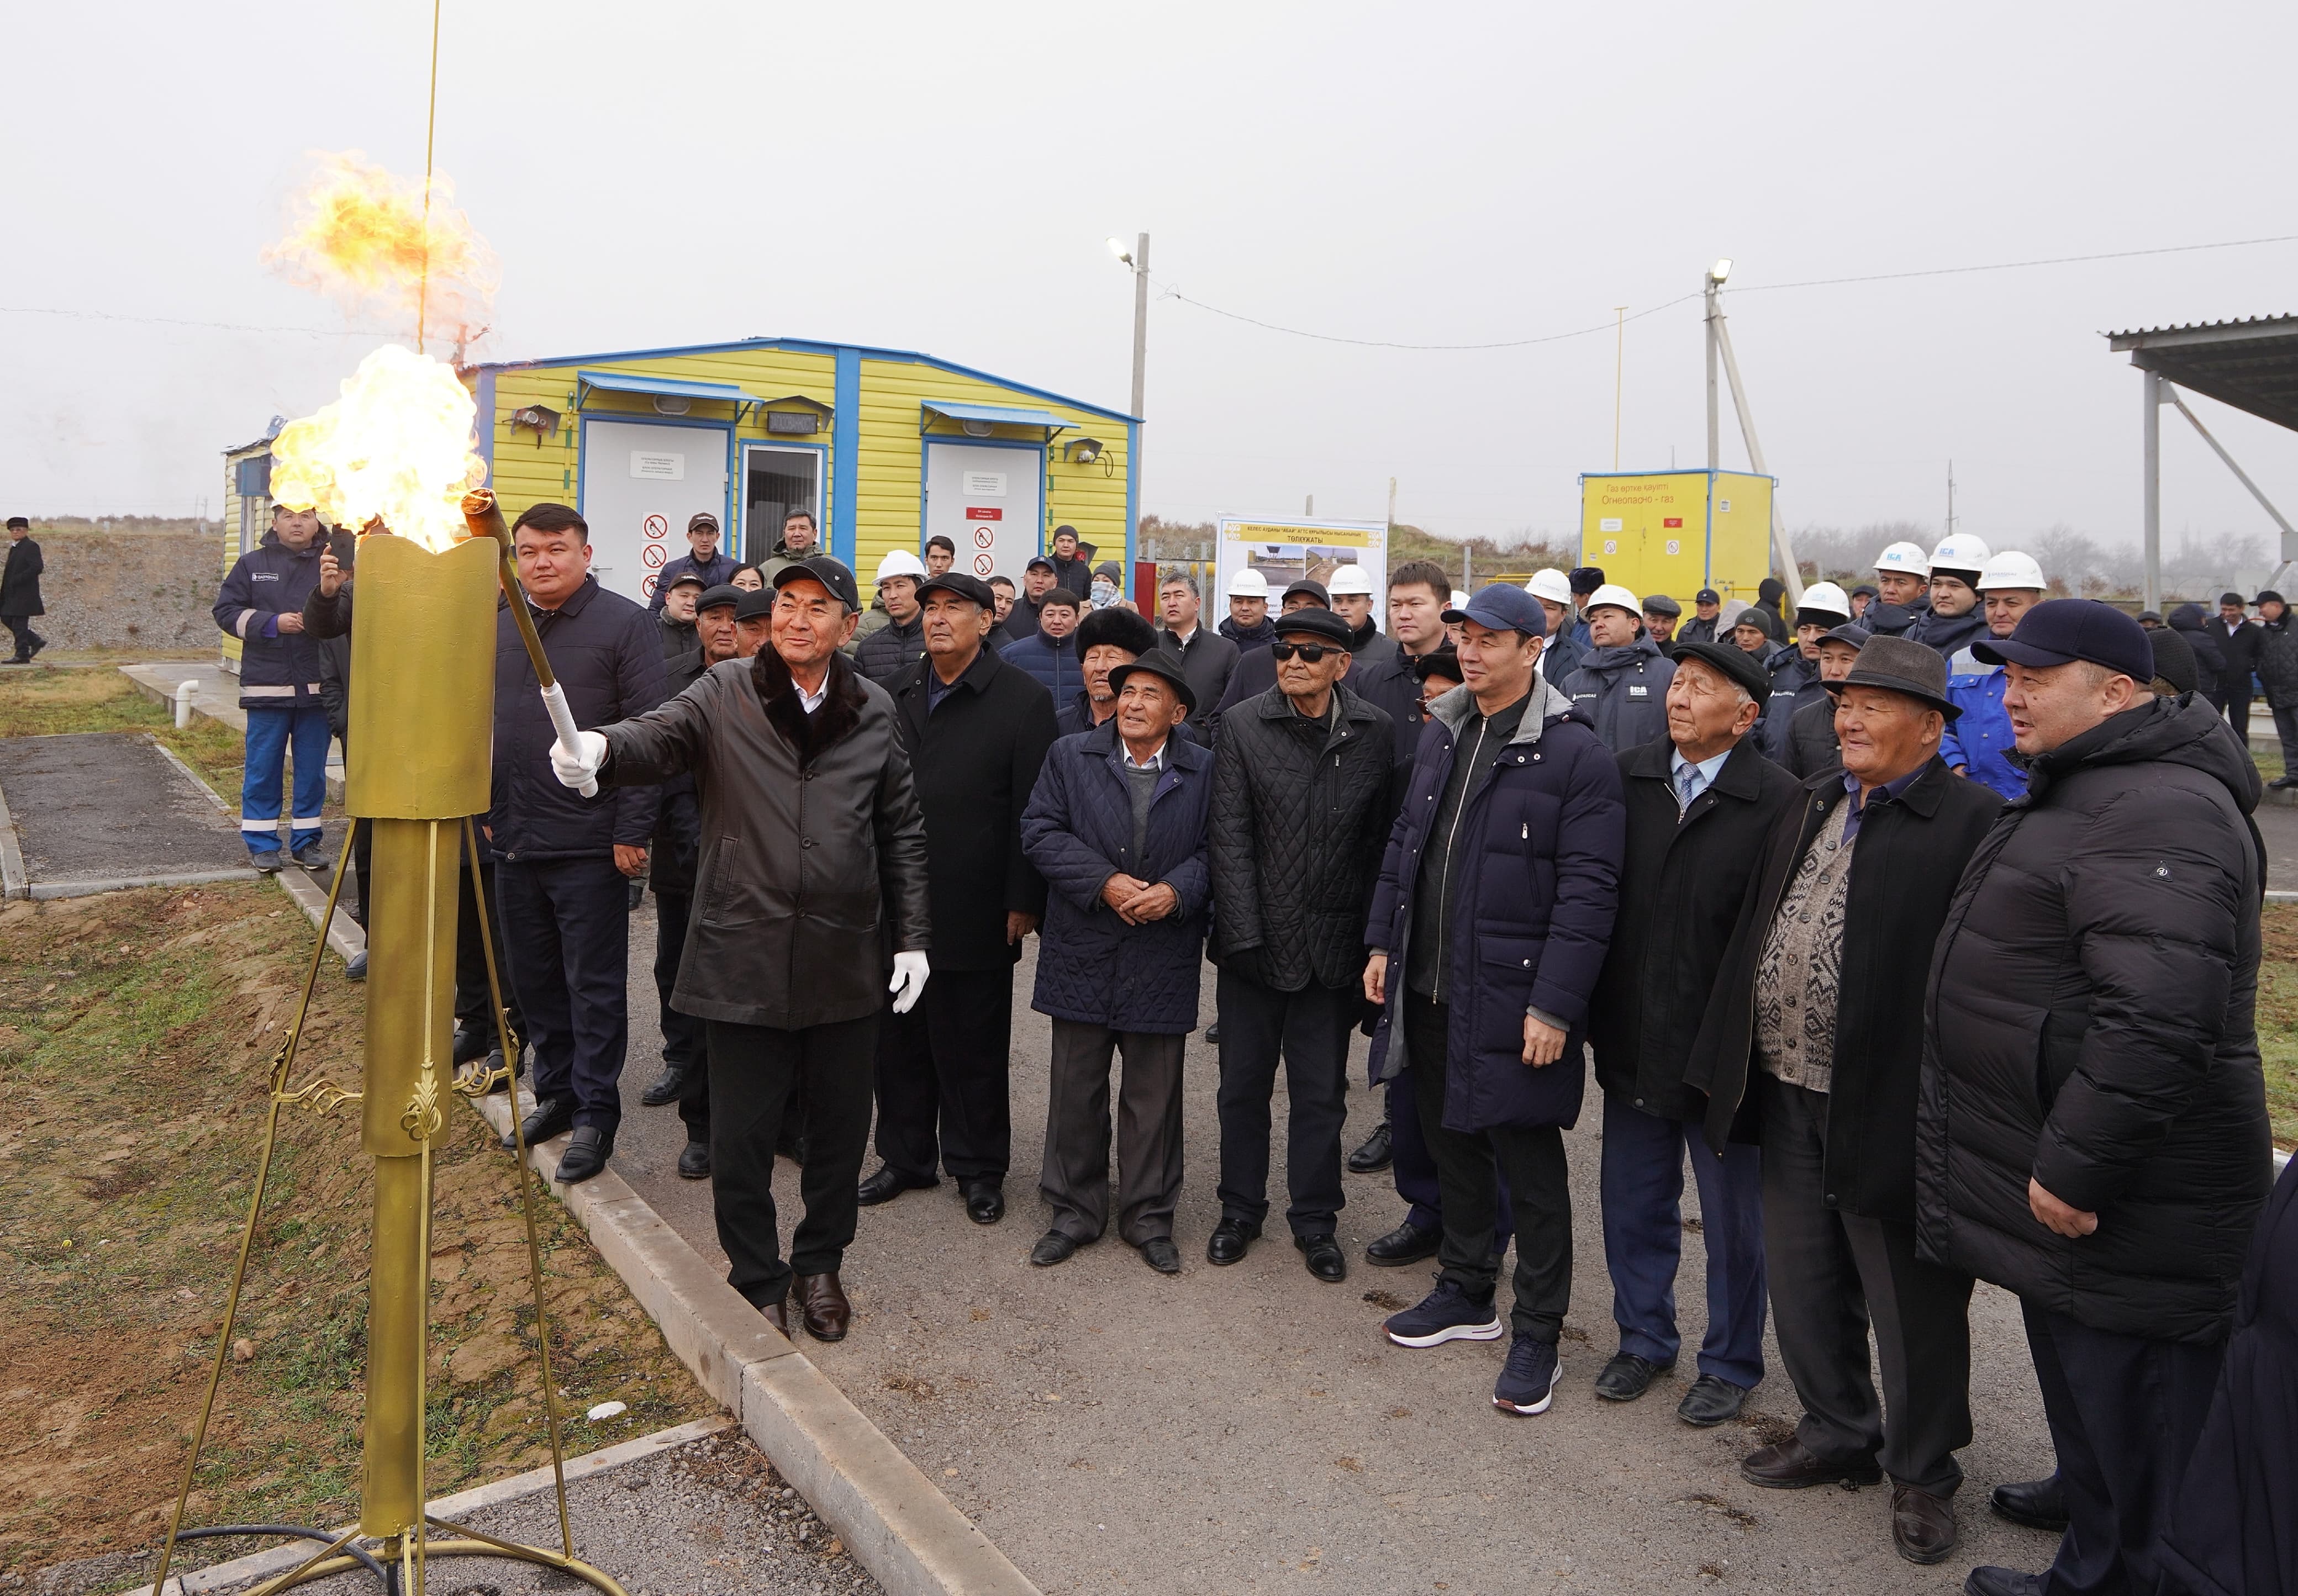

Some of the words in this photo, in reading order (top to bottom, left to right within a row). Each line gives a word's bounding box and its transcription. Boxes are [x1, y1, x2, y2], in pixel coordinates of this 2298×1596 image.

[1607, 484, 1619, 493] Газ
[1602, 495, 1653, 505] Огнеопасно
[1288, 535, 1324, 544] ТӨЛҚҰЖАТЫ
